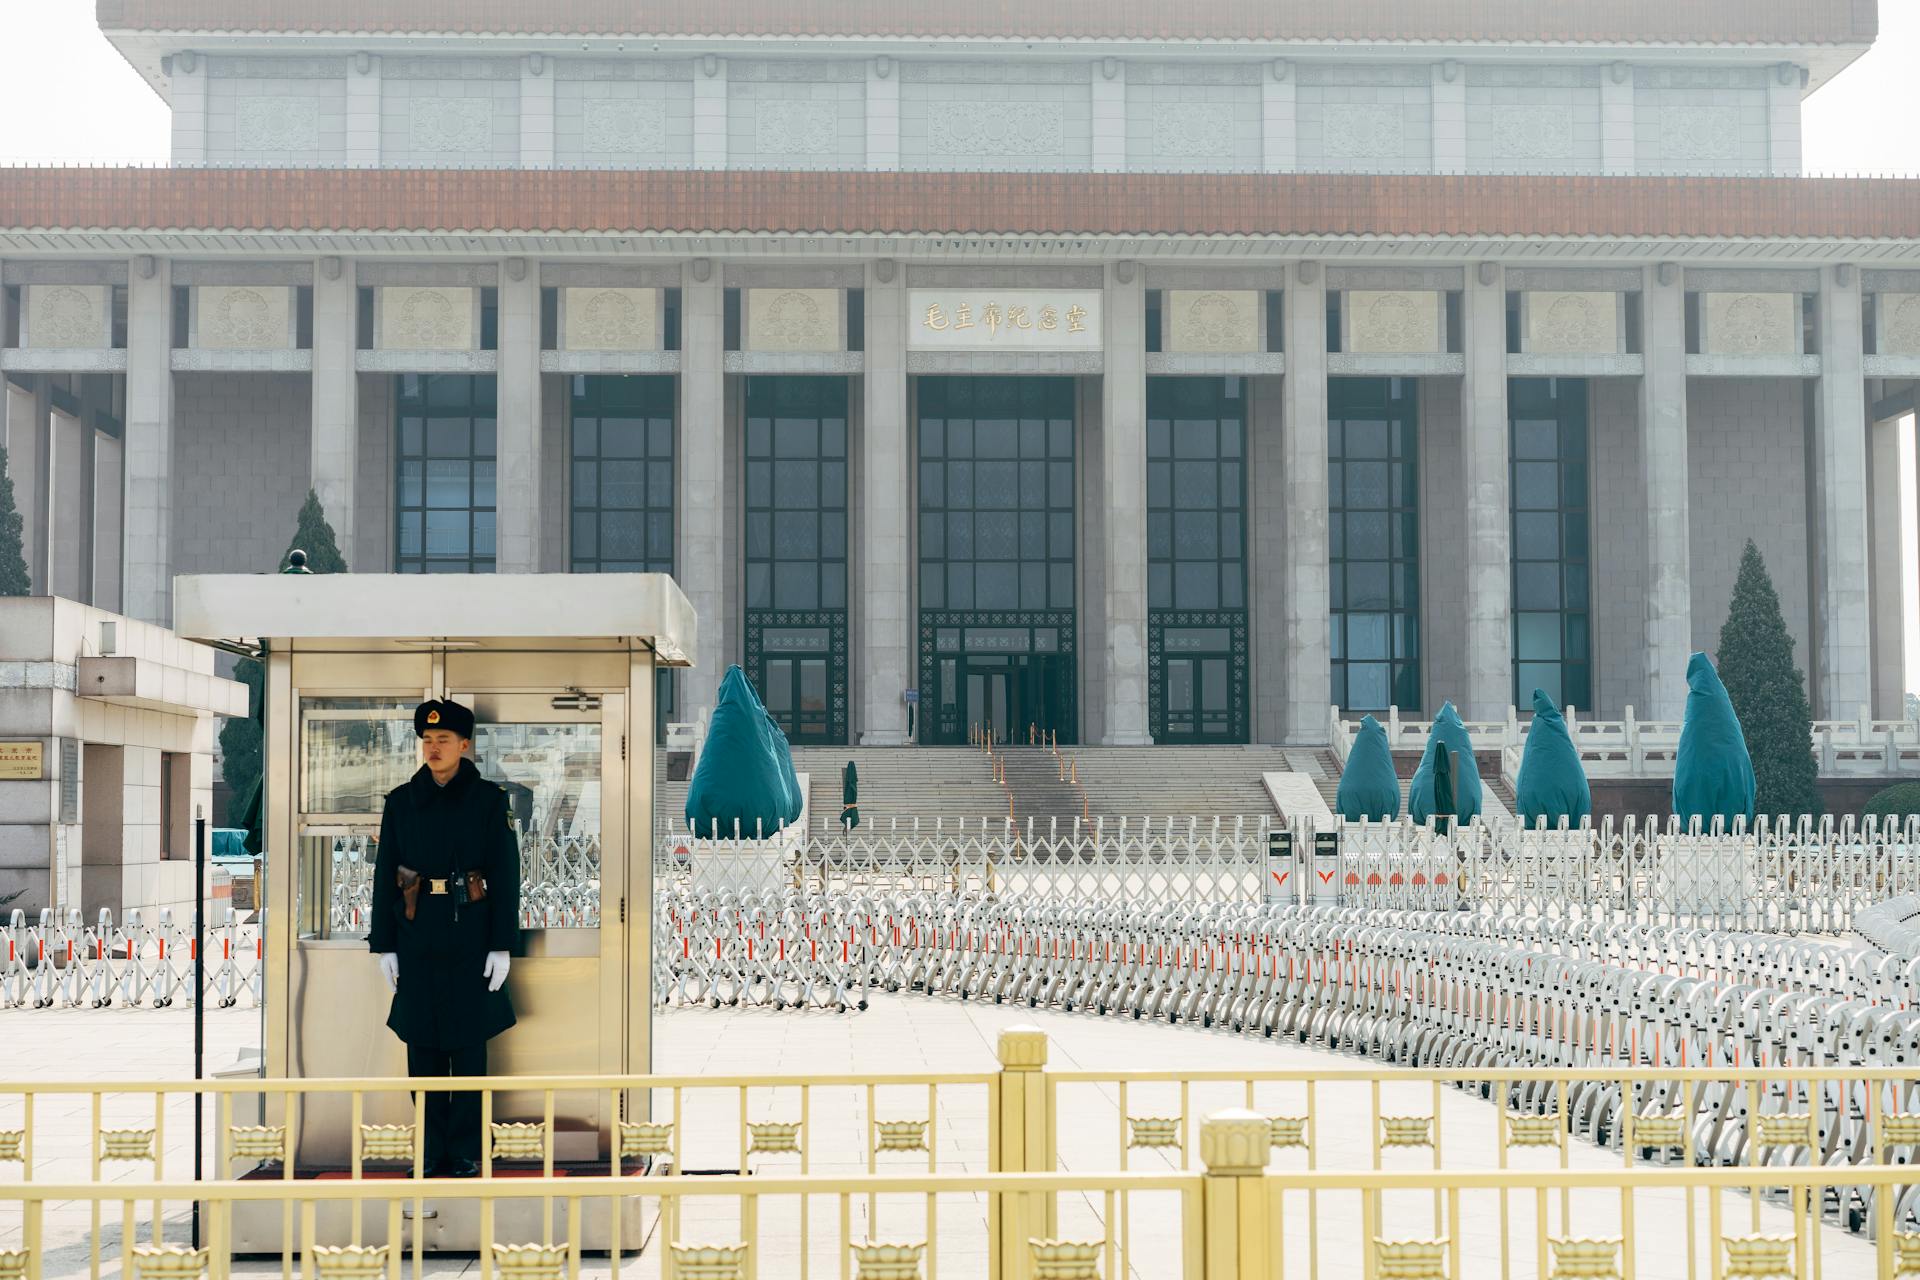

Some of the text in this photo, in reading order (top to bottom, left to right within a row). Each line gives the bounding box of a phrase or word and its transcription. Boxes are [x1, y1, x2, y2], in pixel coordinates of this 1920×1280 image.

[923, 302, 1087, 336] 毛主席纪念堂
